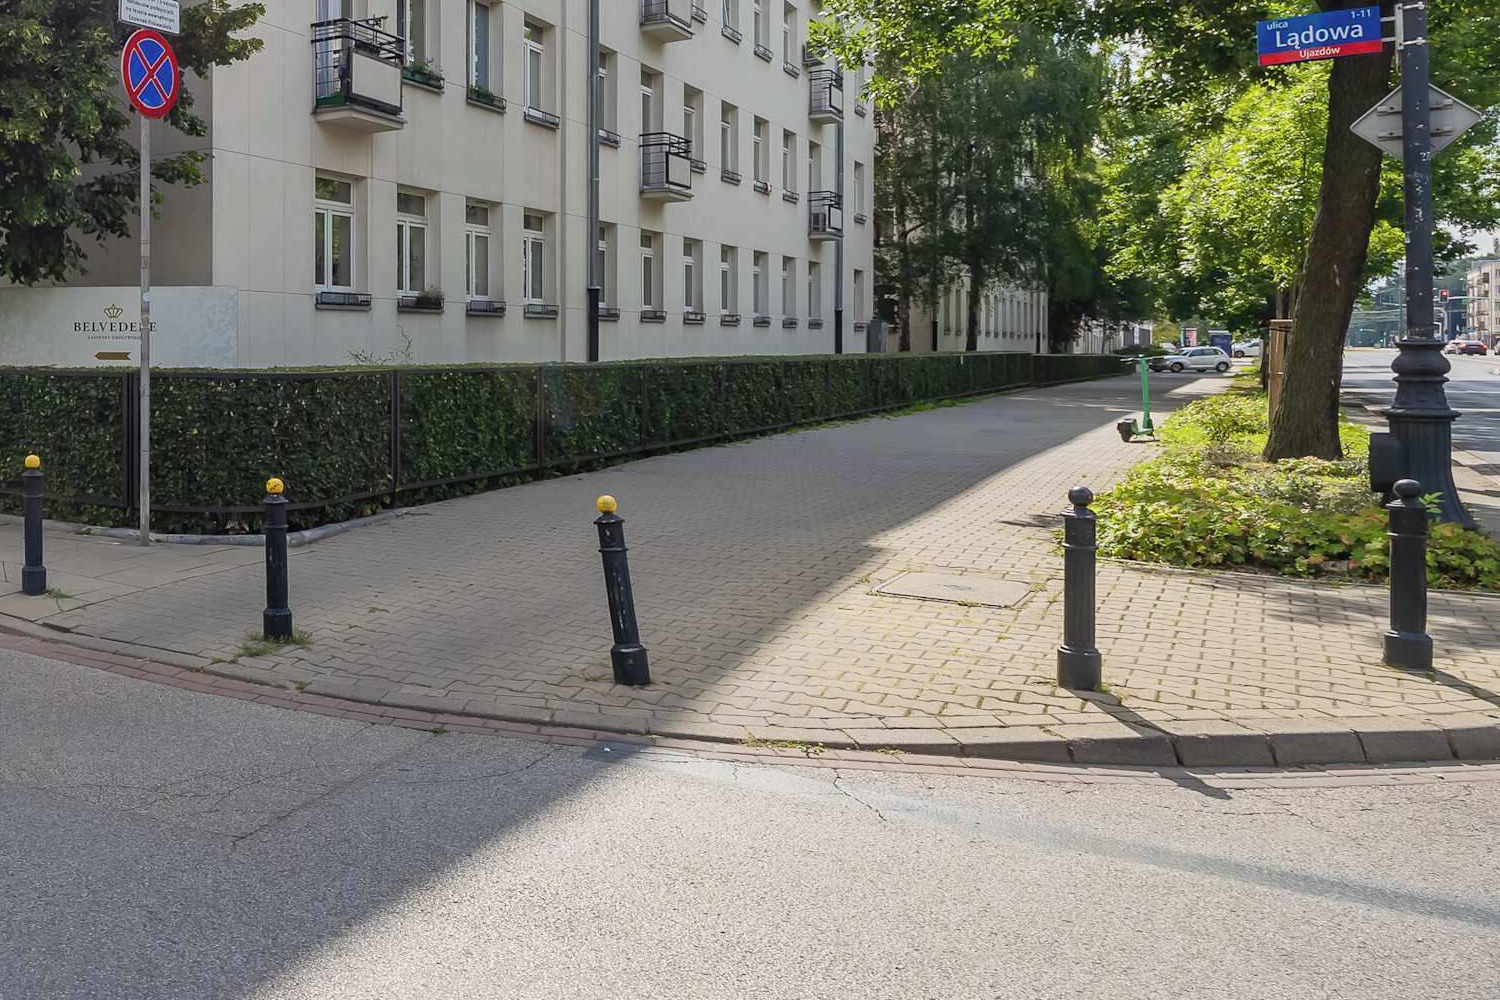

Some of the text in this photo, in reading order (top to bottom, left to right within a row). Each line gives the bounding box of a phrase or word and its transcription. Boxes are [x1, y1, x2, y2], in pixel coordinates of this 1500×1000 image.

[1351, 9, 1371, 19] 1-11
[1266, 21, 1288, 30] ulica
[1275, 24, 1364, 49] Lądowa
[1299, 47, 1341, 59] Ujazdów
[73, 322, 157, 332] BELVEDEE
